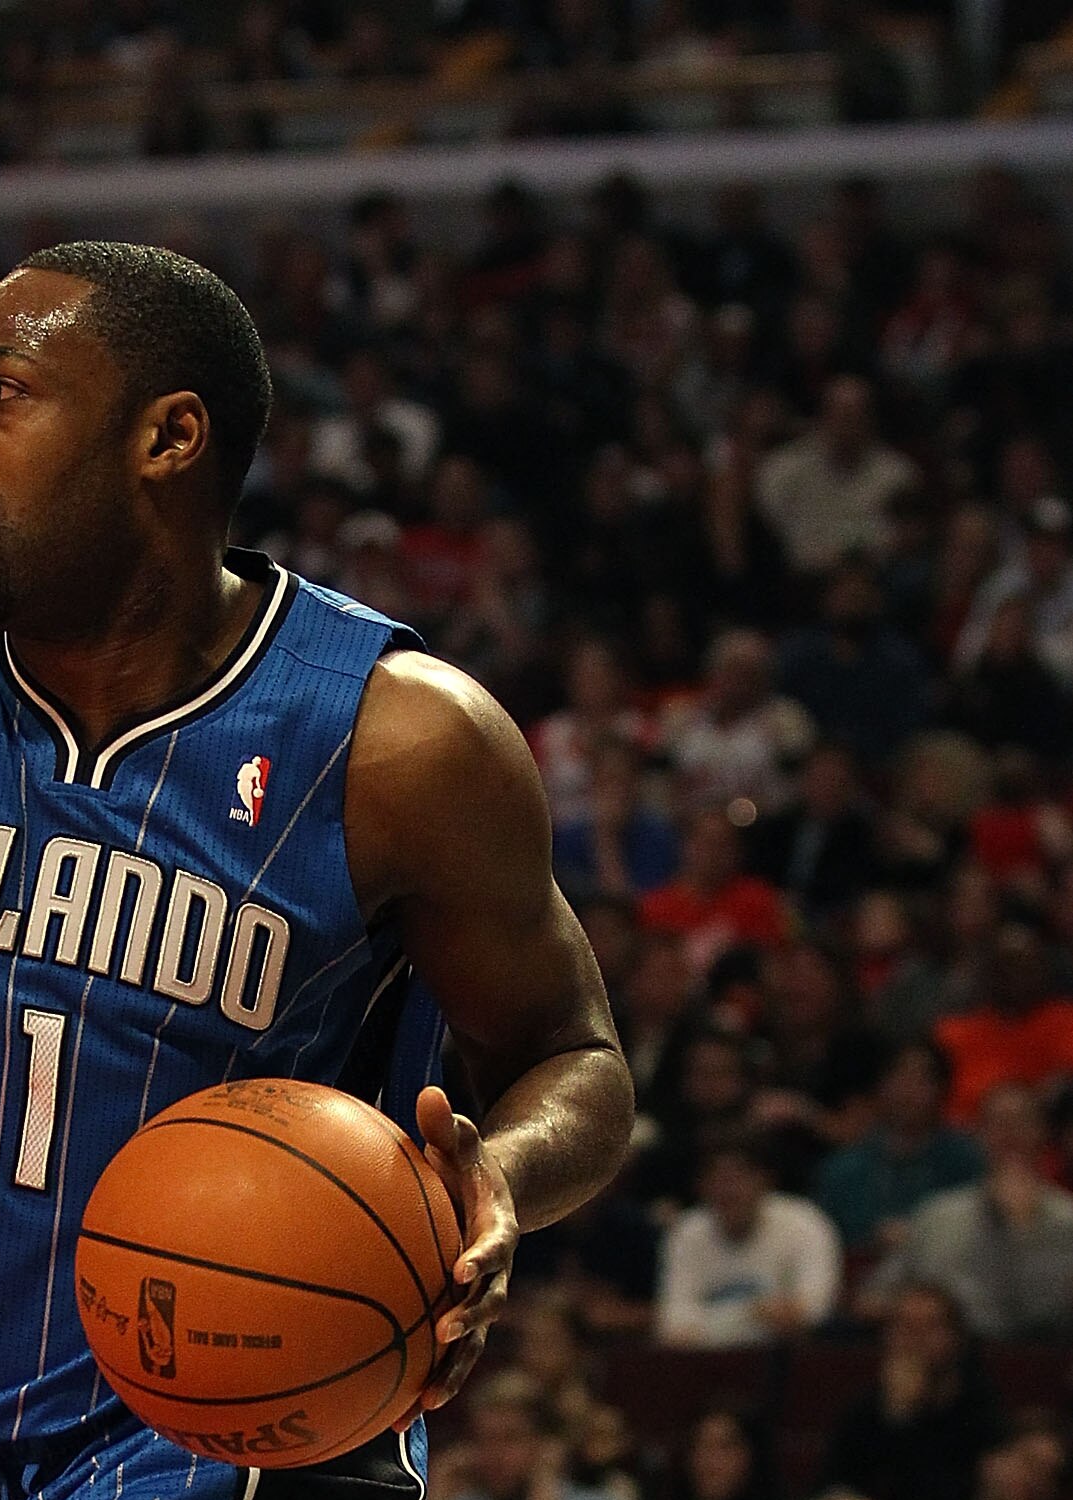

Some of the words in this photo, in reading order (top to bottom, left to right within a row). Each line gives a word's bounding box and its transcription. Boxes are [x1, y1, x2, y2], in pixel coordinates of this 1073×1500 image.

[229, 807, 249, 822] NBA
[14, 1008, 67, 1191] 1
[187, 1330, 209, 1346] BALL
[211, 1333, 237, 1348] GAME
[164, 1408, 321, 1457] SPAL
